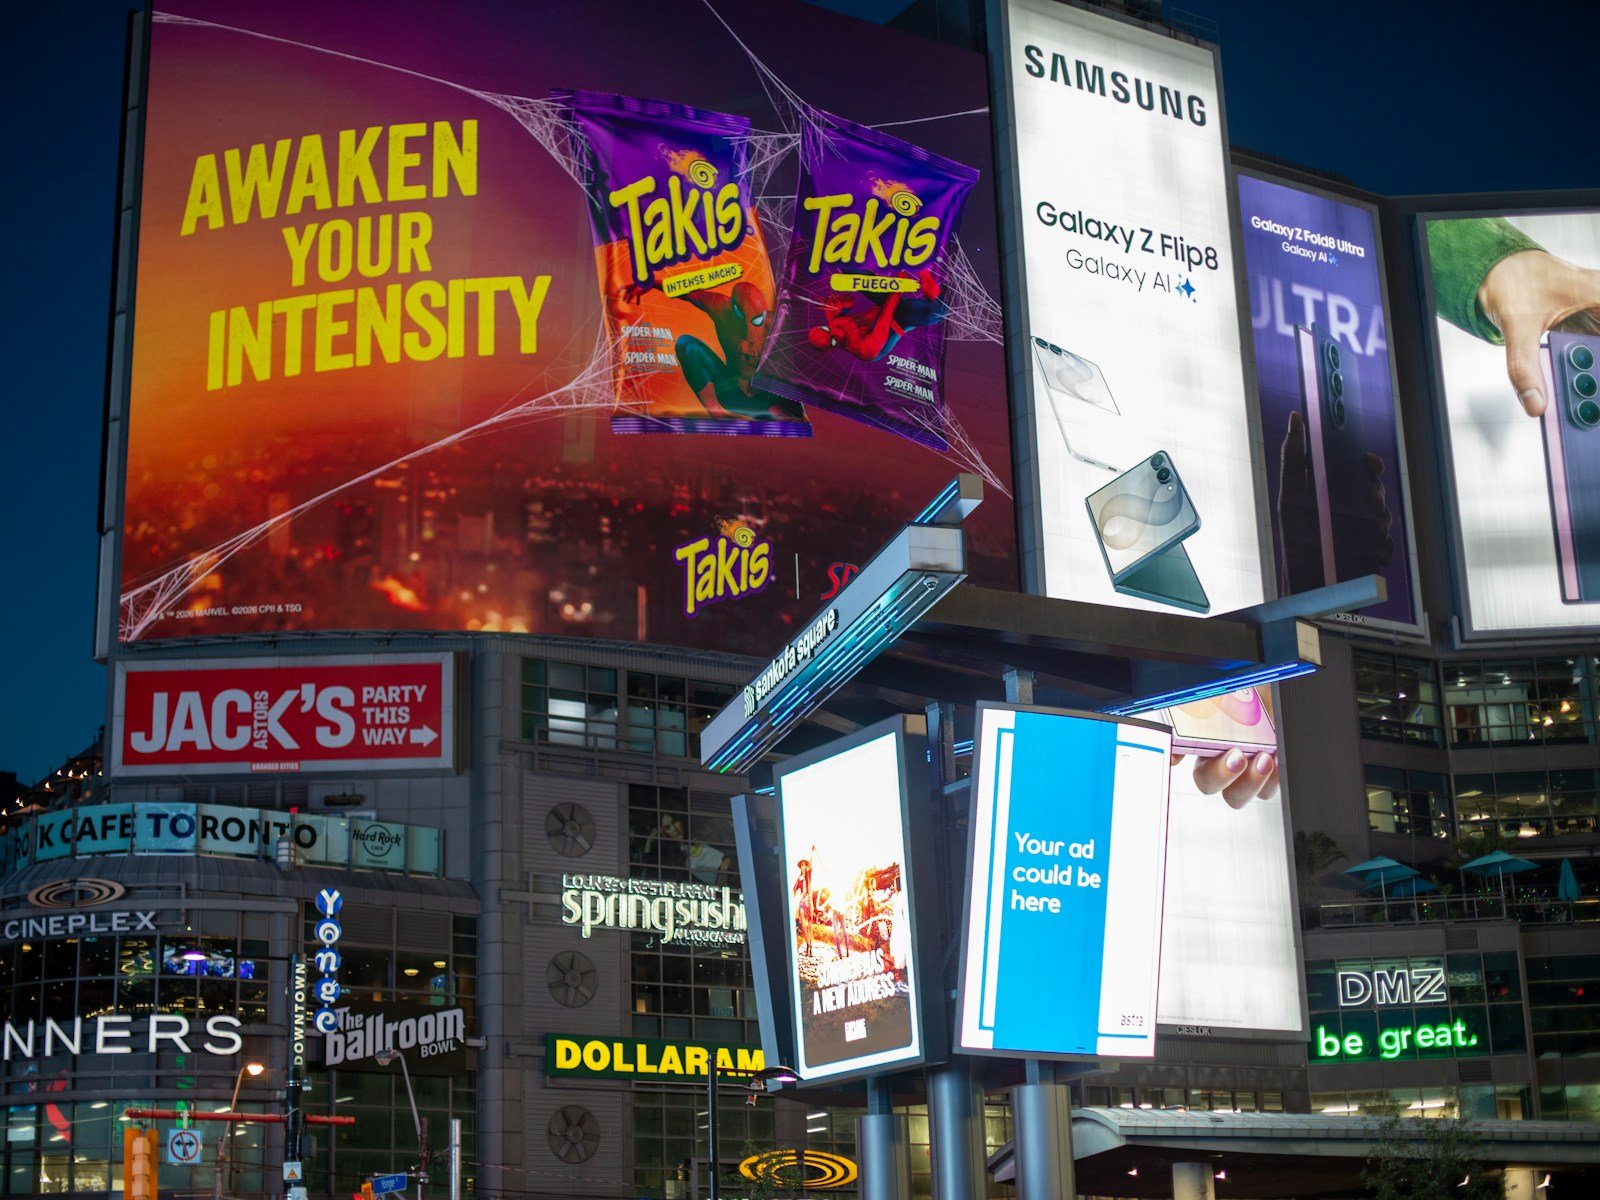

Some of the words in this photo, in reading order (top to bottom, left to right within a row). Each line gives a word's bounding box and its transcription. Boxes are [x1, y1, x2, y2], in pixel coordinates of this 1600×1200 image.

[1024, 44, 1207, 127] SAMSUNG
[180, 119, 478, 237] AWAKEN
[609, 163, 742, 281] Takis
[804, 192, 940, 273] Takis
[1036, 201, 1135, 253] Galaxy
[1140, 228, 1155, 254] Z
[1160, 233, 1219, 272] Flip8
[1251, 216, 1294, 240] Galaxy
[1295, 228, 1304, 242] Z
[1304, 230, 1336, 250] Fold8
[1337, 239, 1365, 258] Ultra
[282, 211, 432, 287] YOUR
[1282, 242, 1317, 262] Galaxy
[1318, 252, 1328, 263] AI
[667, 275, 705, 293] INTENSE
[708, 266, 737, 281] NACHO
[853, 277, 899, 290] FUEGO
[1066, 249, 1147, 292] Galaxy
[1153, 271, 1171, 293] AI
[207, 275, 552, 391] INTENSITY
[621, 326, 673, 341] SPIDER-MAN
[625, 352, 678, 367] SPIDER-MAN
[886, 354, 937, 382] SPIDER-MAN
[883, 375, 935, 403] SPIDER-MAN
[676, 527, 770, 614] Takis
[176, 610, 195, 619] 2026
[195, 607, 230, 617] MARVEL.
[276, 604, 283, 613] &
[285, 603, 302, 613] TSG
[755, 645, 796, 701] sankofa
[797, 608, 837, 661] square
[363, 684, 427, 704] PARTY
[130, 683, 356, 753] JACK'S
[252, 690, 269, 750] ASTORS
[363, 706, 411, 724] THIS
[363, 727, 407, 746] WAY
[61, 813, 136, 845] CAFE
[147, 813, 317, 849] TORONTO
[353, 829, 377, 842] Hard
[378, 832, 401, 846] Rock
[1014, 831, 1065, 856] Your
[1068, 838, 1095, 860] ad
[1012, 863, 1073, 886] could
[1077, 866, 1102, 889] be
[1010, 888, 1062, 914] here
[4, 910, 156, 939] CINEPLEX
[315, 888, 341, 1034] Yonge
[813, 991, 822, 1015] A
[847, 972, 896, 1007] ADDRESS
[1338, 967, 1447, 1007] DMZ
[294, 963, 306, 1065] DOWNTOWN
[334, 1006, 364, 1031] The
[1176, 1025, 1210, 1036] CIESLOK
[3, 1015, 243, 1061] NNERS
[325, 1008, 466, 1066] ballroom
[420, 1040, 456, 1058] BOWL
[1318, 1025, 1364, 1056] be
[1380, 1018, 1478, 1059] great.
[555, 1039, 765, 1077] DOLLARAM
